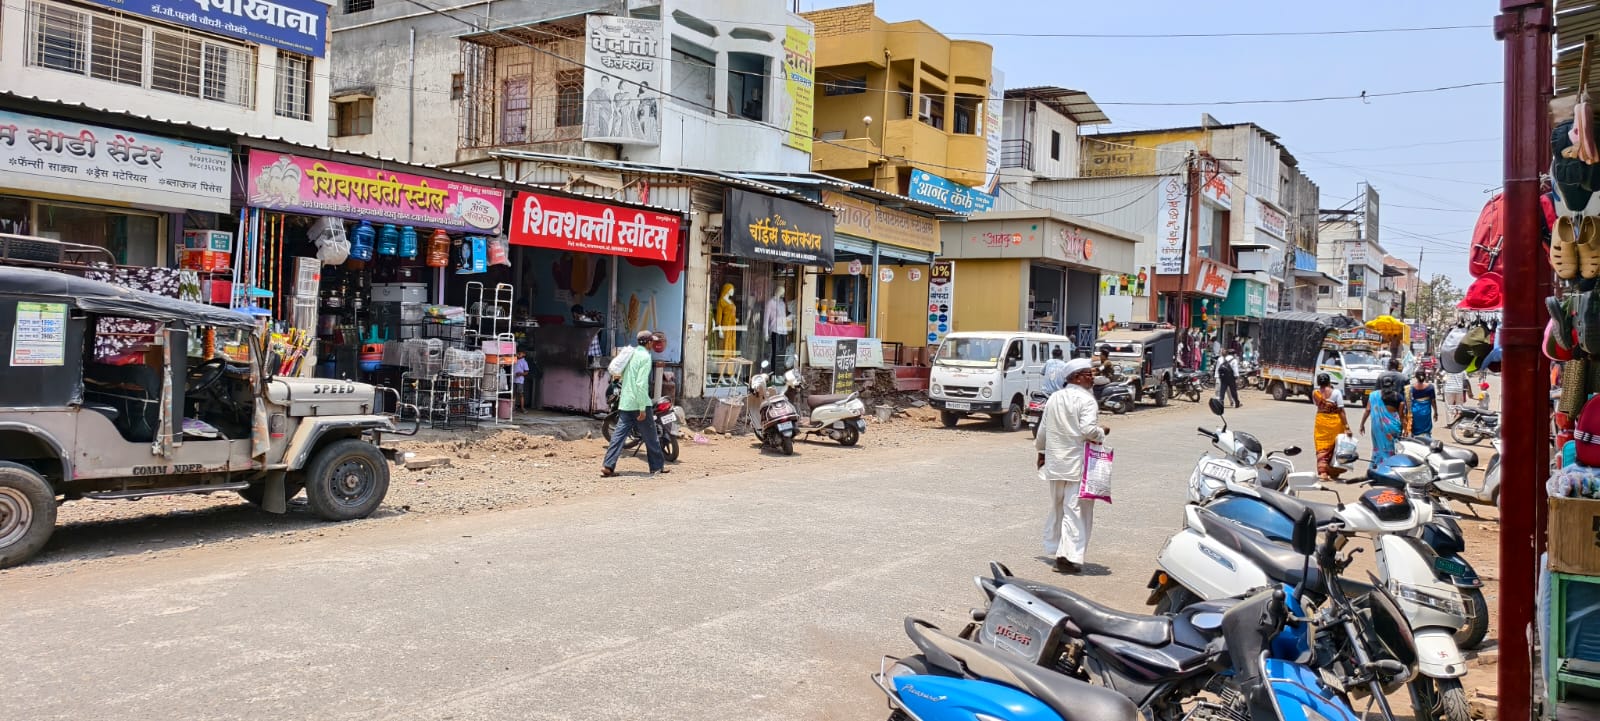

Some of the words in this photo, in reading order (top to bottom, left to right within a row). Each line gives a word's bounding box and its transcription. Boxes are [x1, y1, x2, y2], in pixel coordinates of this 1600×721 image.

[601, 54, 654, 72] कलेक्शन
[27, 129, 99, 158] साडी
[106, 134, 164, 169] सेंटर
[48, 162, 78, 174] साड्या
[112, 169, 148, 184] मटेरियल
[166, 178, 198, 191] ब्लाऊज
[305, 161, 401, 207] शिवपार्वती
[401, 179, 449, 211] स्टील
[916, 181, 950, 204] आनंद
[950, 187, 974, 208] कॅफे
[522, 195, 616, 243] शिवशक्ती
[617, 212, 671, 262] स्वीटस्
[749, 216, 779, 246] चॉईस
[781, 224, 822, 251] कलेक्शन
[313, 384, 355, 394] SPEED
